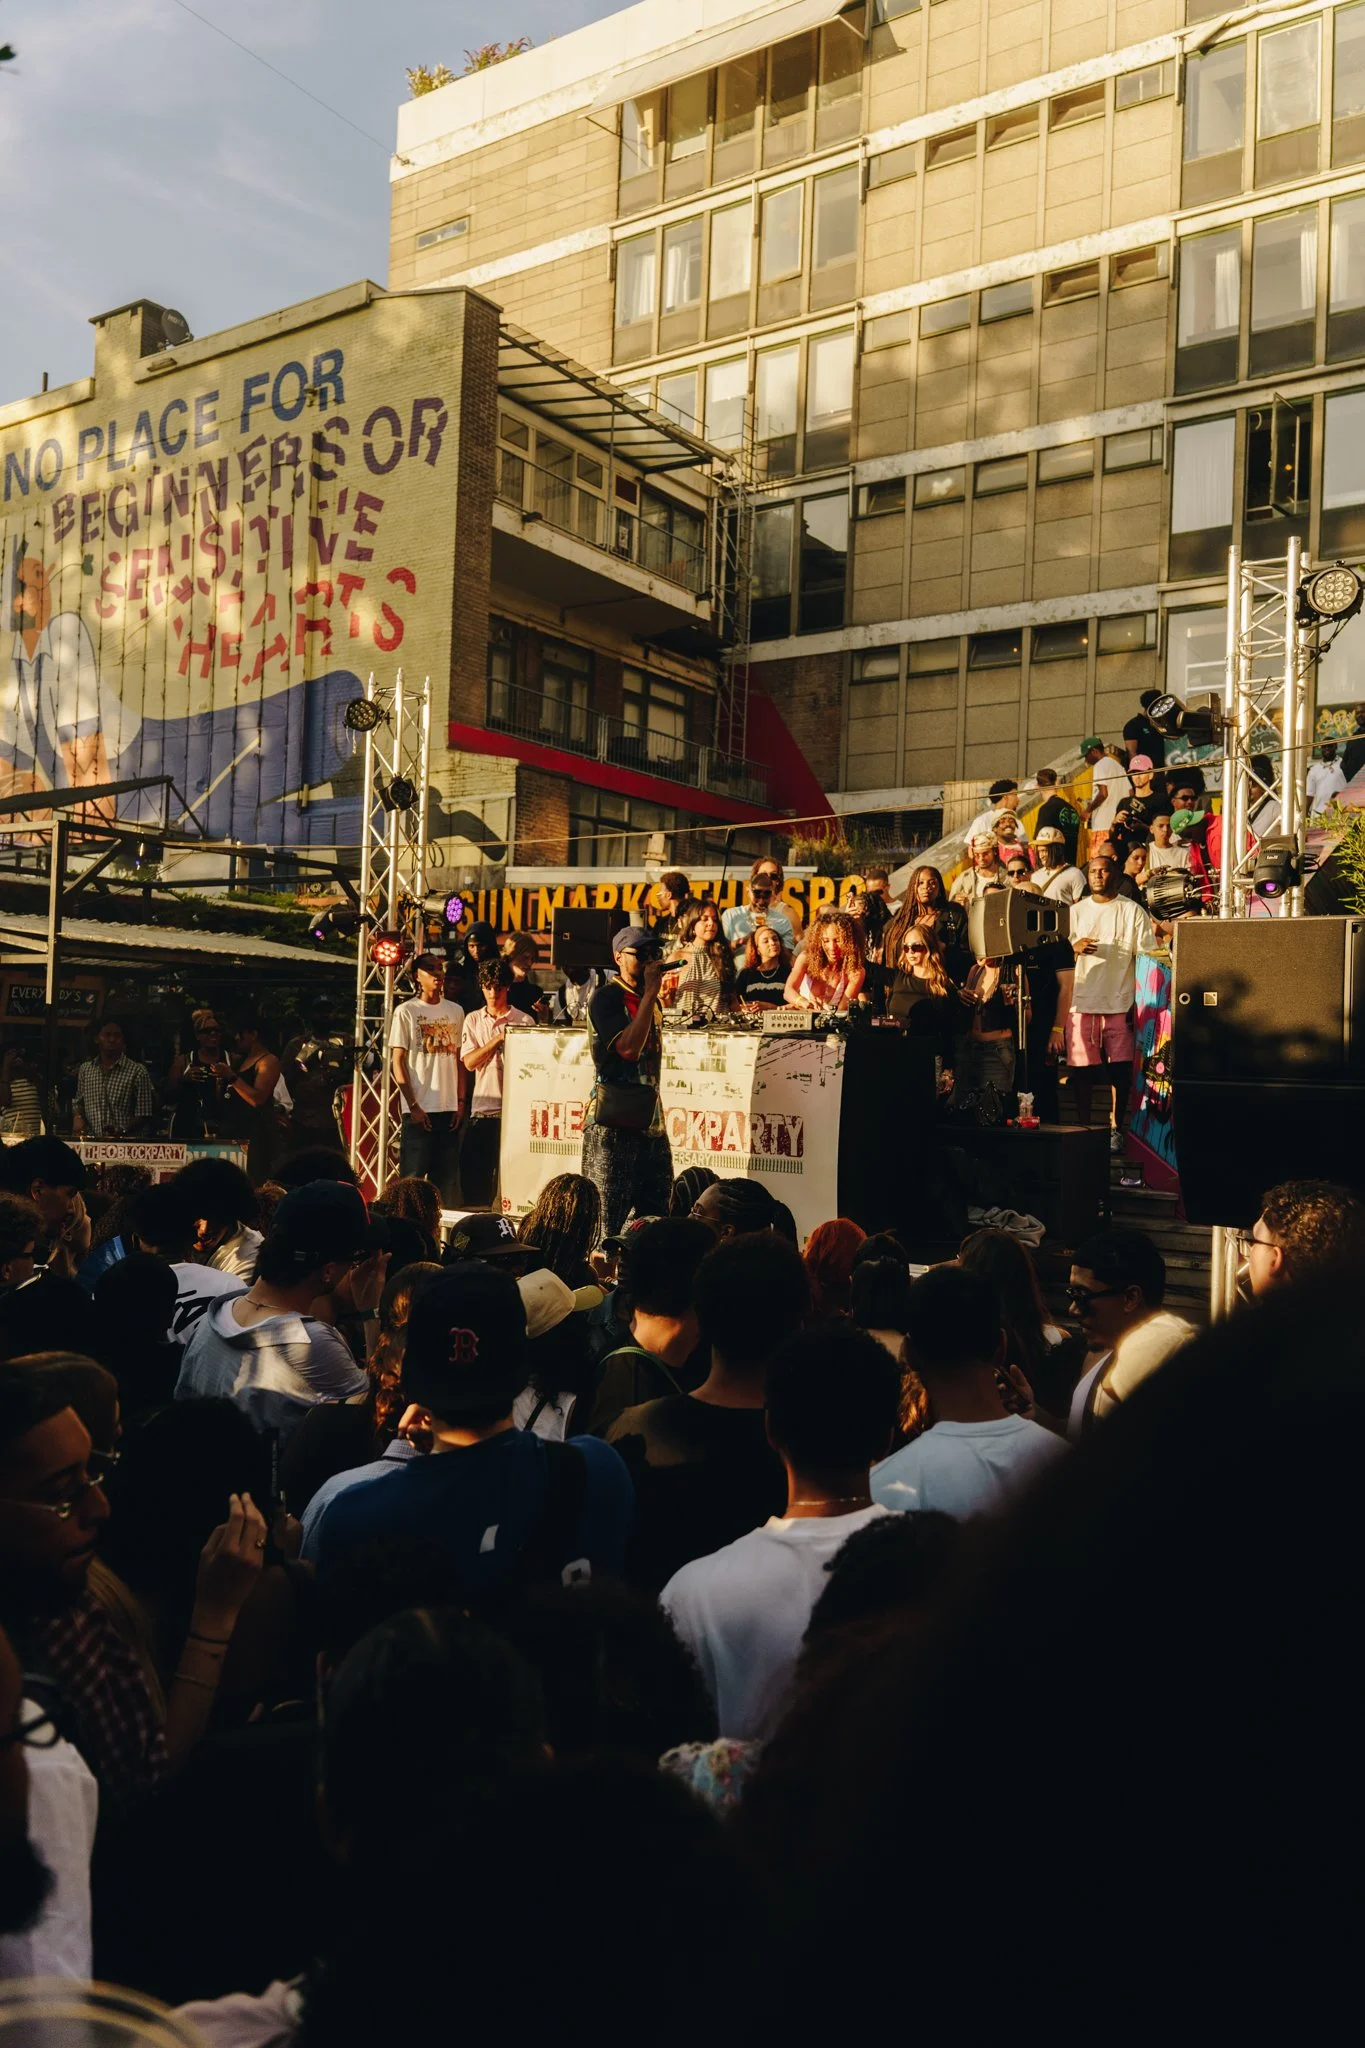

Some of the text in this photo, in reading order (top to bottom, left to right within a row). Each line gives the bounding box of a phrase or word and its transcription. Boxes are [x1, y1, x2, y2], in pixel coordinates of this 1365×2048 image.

[3, 348, 347, 500] NO PLACE FOR
[52, 397, 448, 545] BEGINNERS OR
[95, 487, 385, 620] SENSITIVE
[173, 567, 417, 686] HEARTS
[457, 887, 524, 934] SUN
[11, 985, 82, 1003] EVERYDY'S
